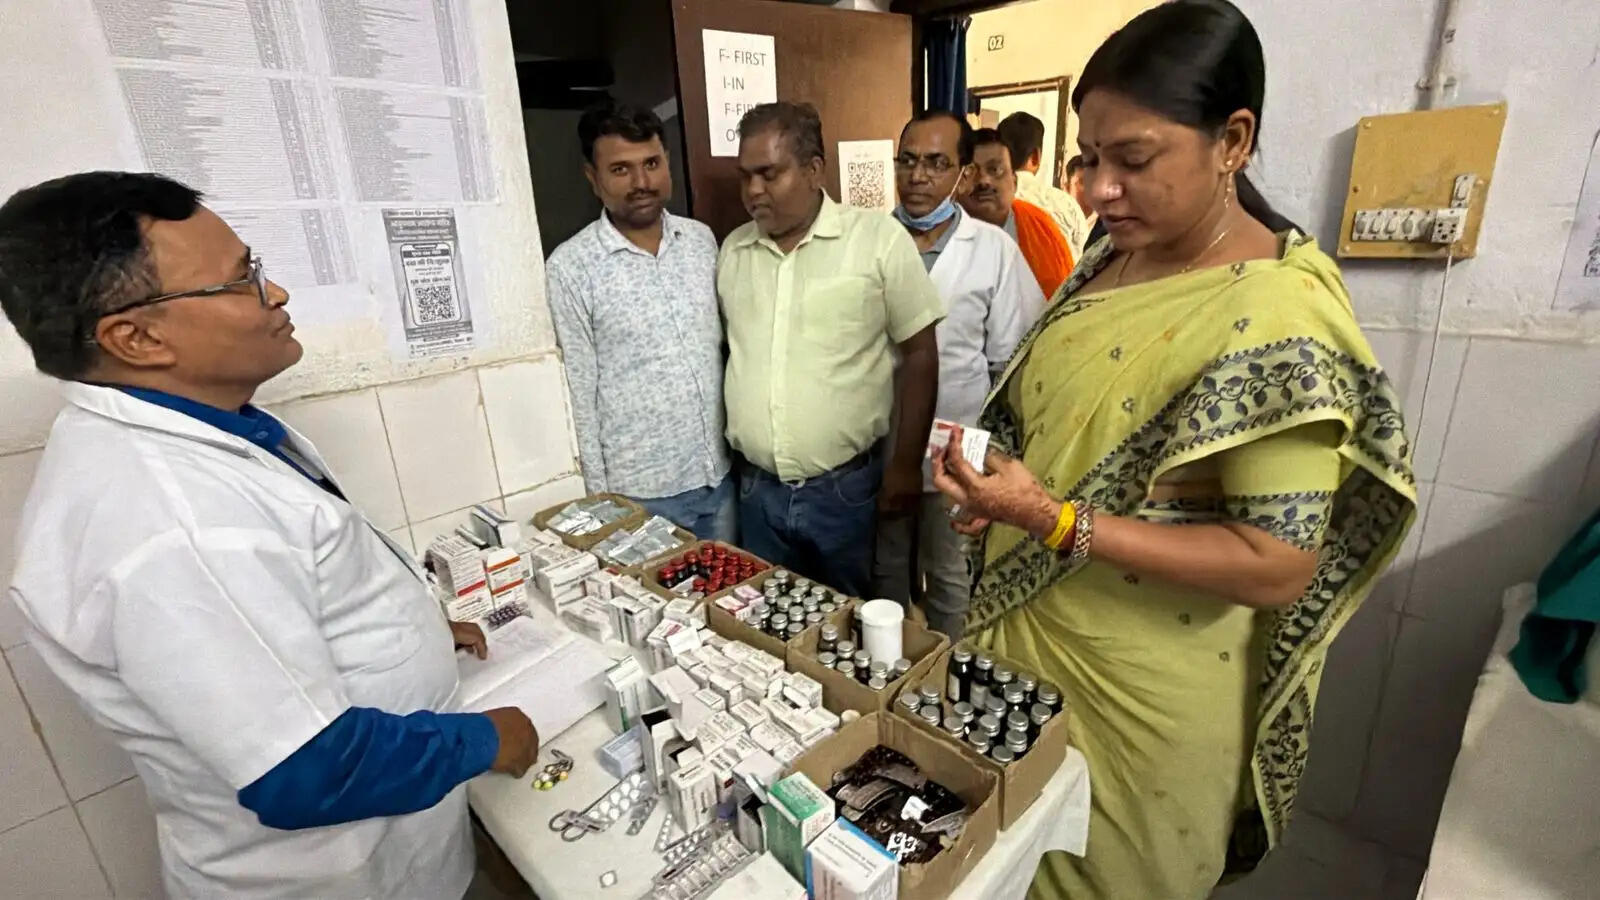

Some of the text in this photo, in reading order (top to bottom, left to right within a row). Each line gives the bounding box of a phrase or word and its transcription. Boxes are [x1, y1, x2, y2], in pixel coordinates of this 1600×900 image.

[734, 50, 767, 67] FIRST
[723, 75, 745, 90] I-IN
[724, 102, 754, 116] F-FI
